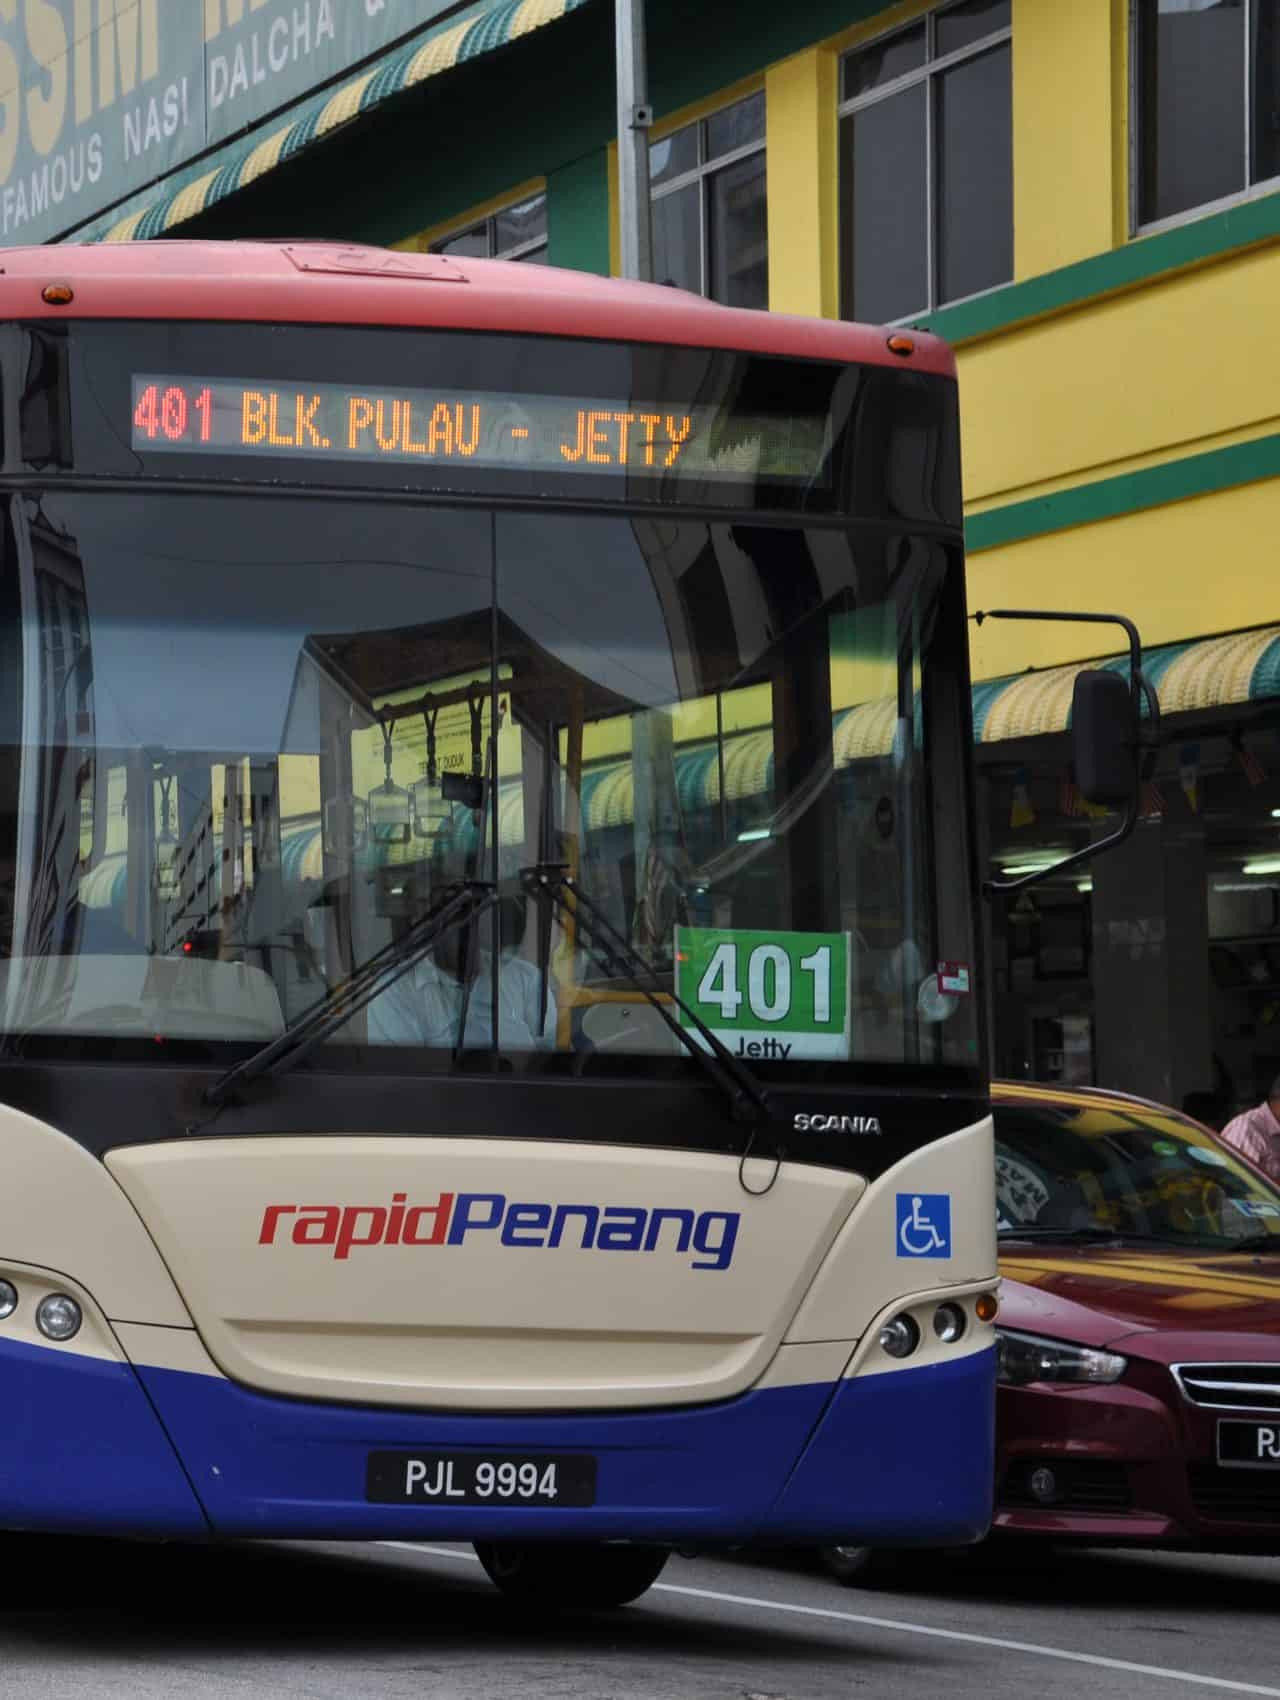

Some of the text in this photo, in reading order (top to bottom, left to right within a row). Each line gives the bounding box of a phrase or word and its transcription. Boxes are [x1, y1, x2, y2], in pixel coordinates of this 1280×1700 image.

[2, 131, 104, 235] FAMOUS
[122, 75, 189, 161] NASI
[208, 0, 336, 109] DALCHA
[133, 385, 212, 441] 401
[240, 390, 331, 449] BLK.
[347, 396, 481, 456] PULAU
[559, 409, 692, 467] JETTY
[697, 943, 833, 1025] 401
[734, 1037, 792, 1060] Jetty
[793, 1113, 881, 1135] SCANIA
[258, 1193, 741, 1271] rapidPenang
[405, 1460, 558, 1498] PJL 9994
